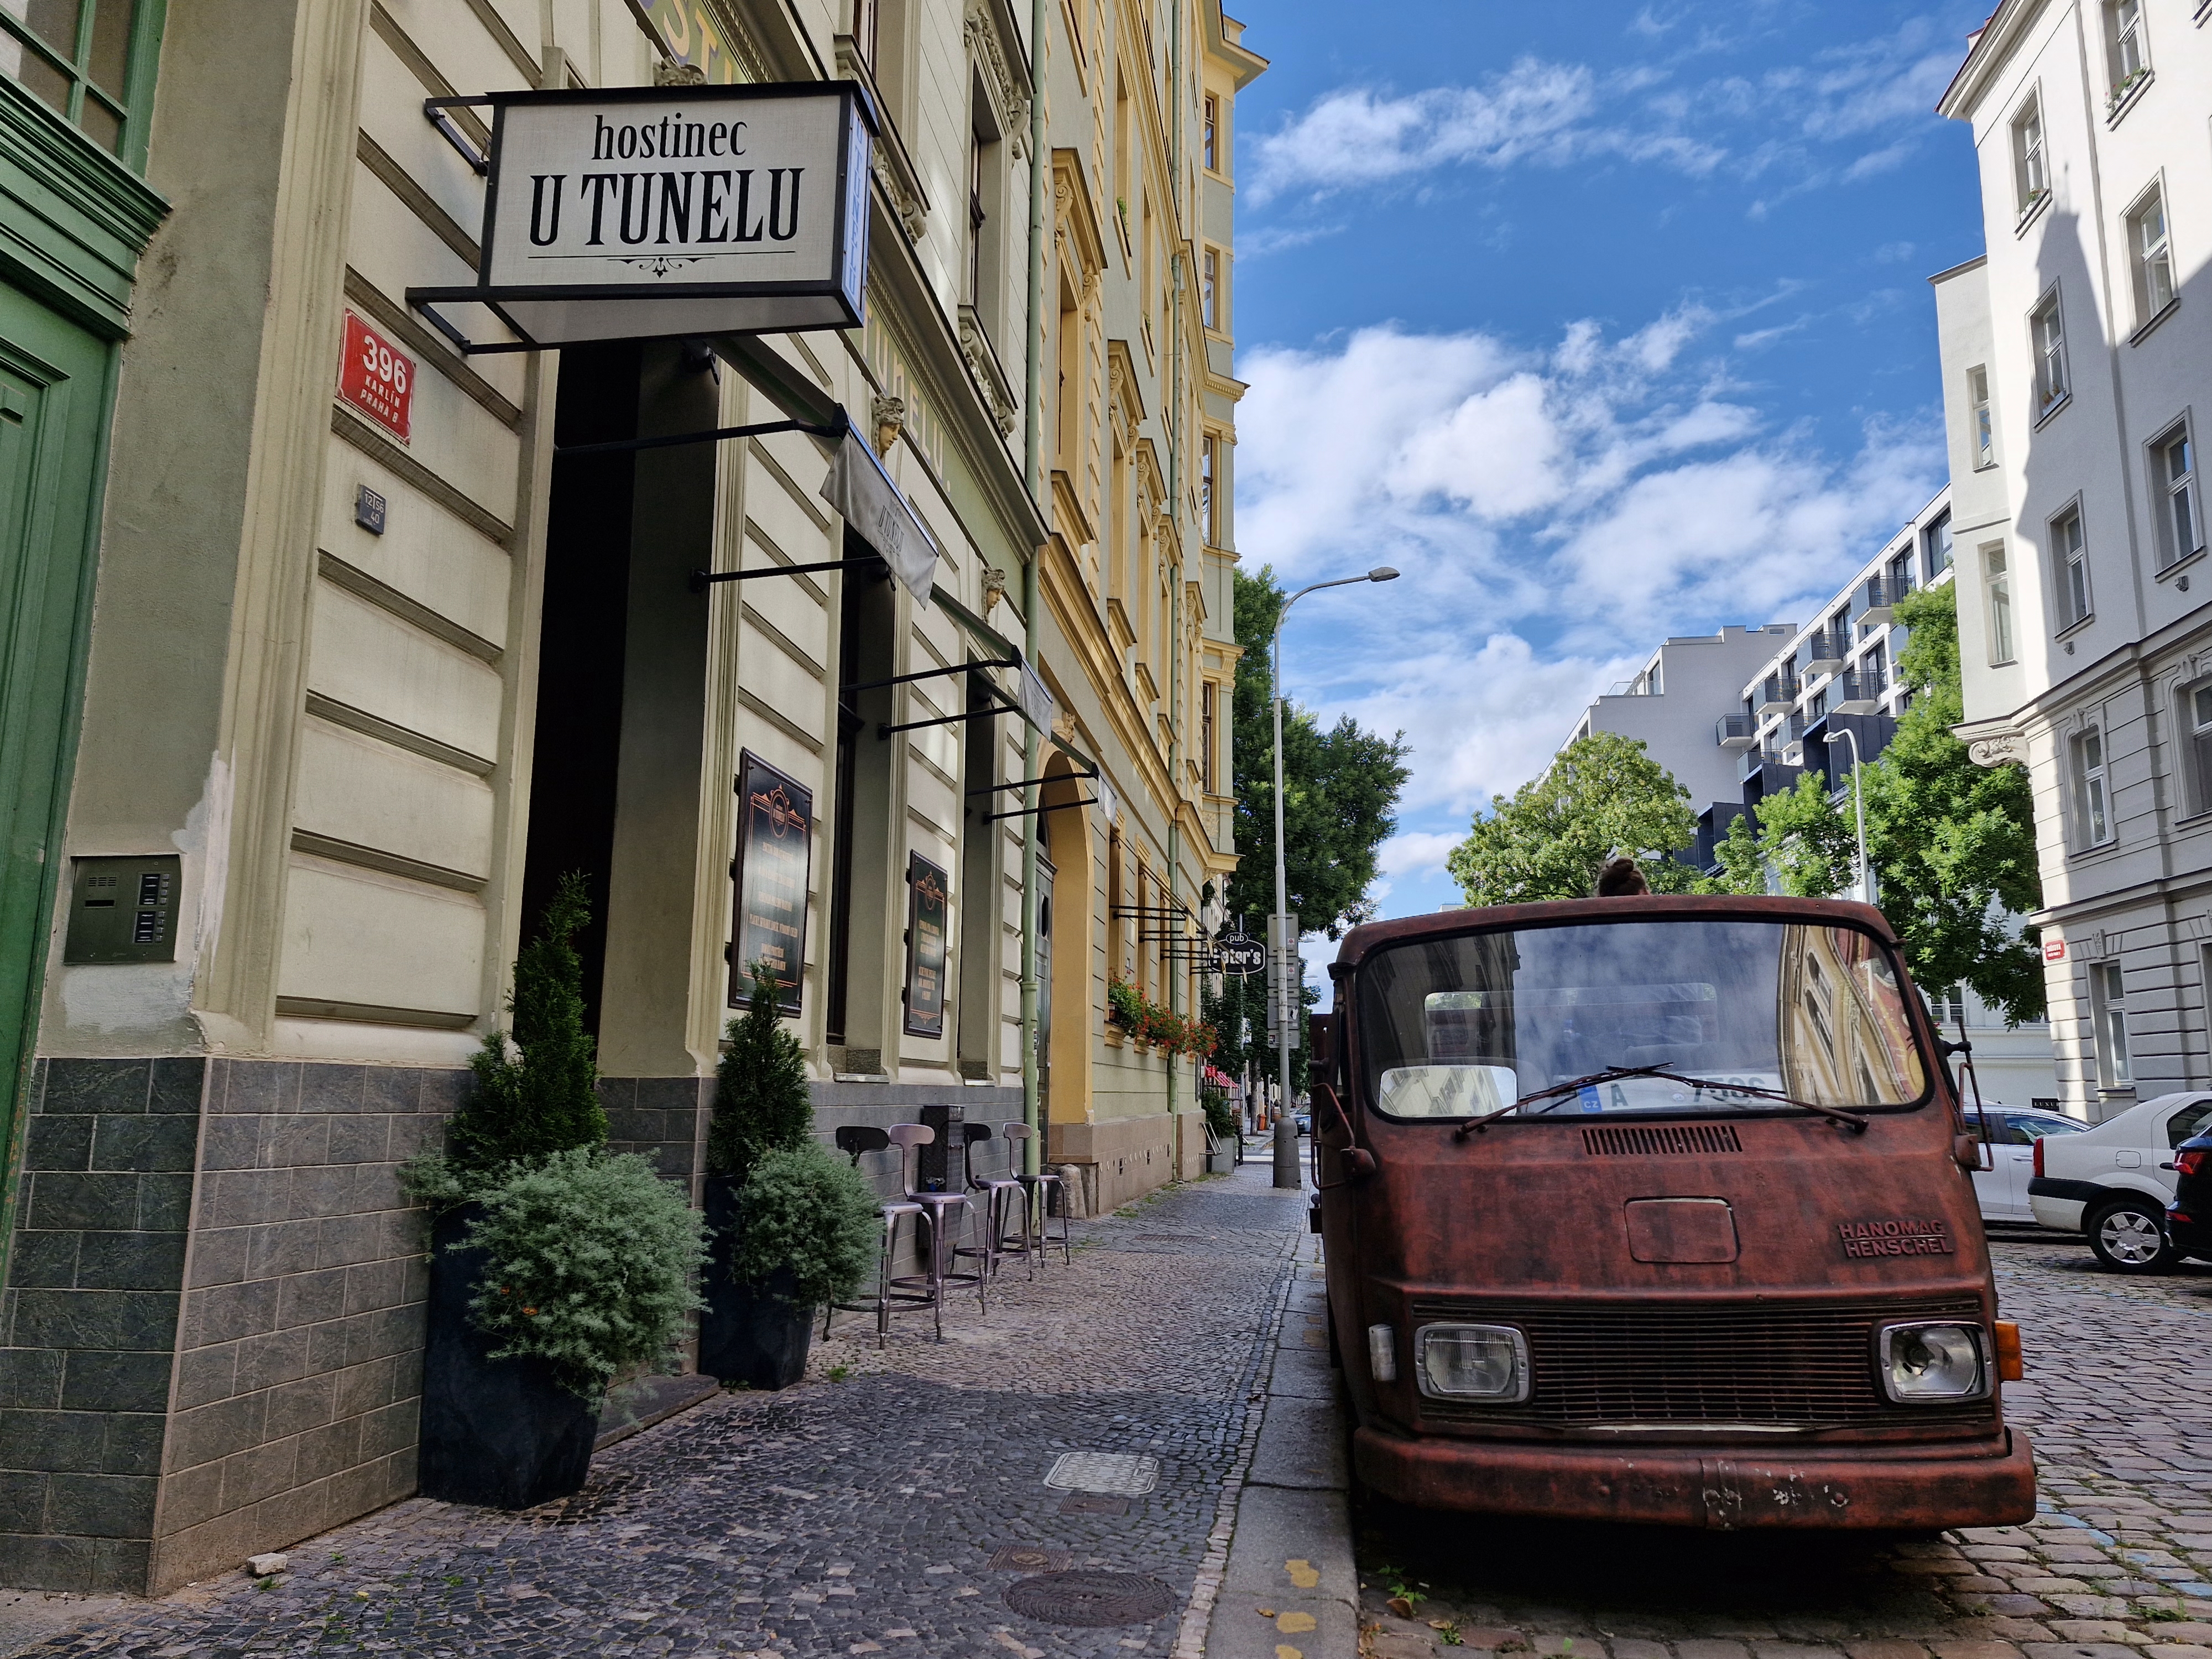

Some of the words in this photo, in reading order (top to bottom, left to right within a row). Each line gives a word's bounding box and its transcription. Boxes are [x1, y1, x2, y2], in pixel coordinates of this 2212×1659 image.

[592, 112, 748, 160] hostinec
[529, 174, 567, 247] U
[581, 168, 806, 247] TUNELU
[848, 145, 863, 295] TUNELU
[362, 335, 406, 394] 396
[359, 389, 389, 418] PRAHA
[392, 411, 399, 424] 8
[364, 374, 400, 409] KARLÍN
[1229, 933, 1244, 943] pub
[1610, 1083, 1629, 1107] A
[1838, 1220, 1946, 1239] HANOMAG
[1844, 1239, 1954, 1258] HENSCHEL
